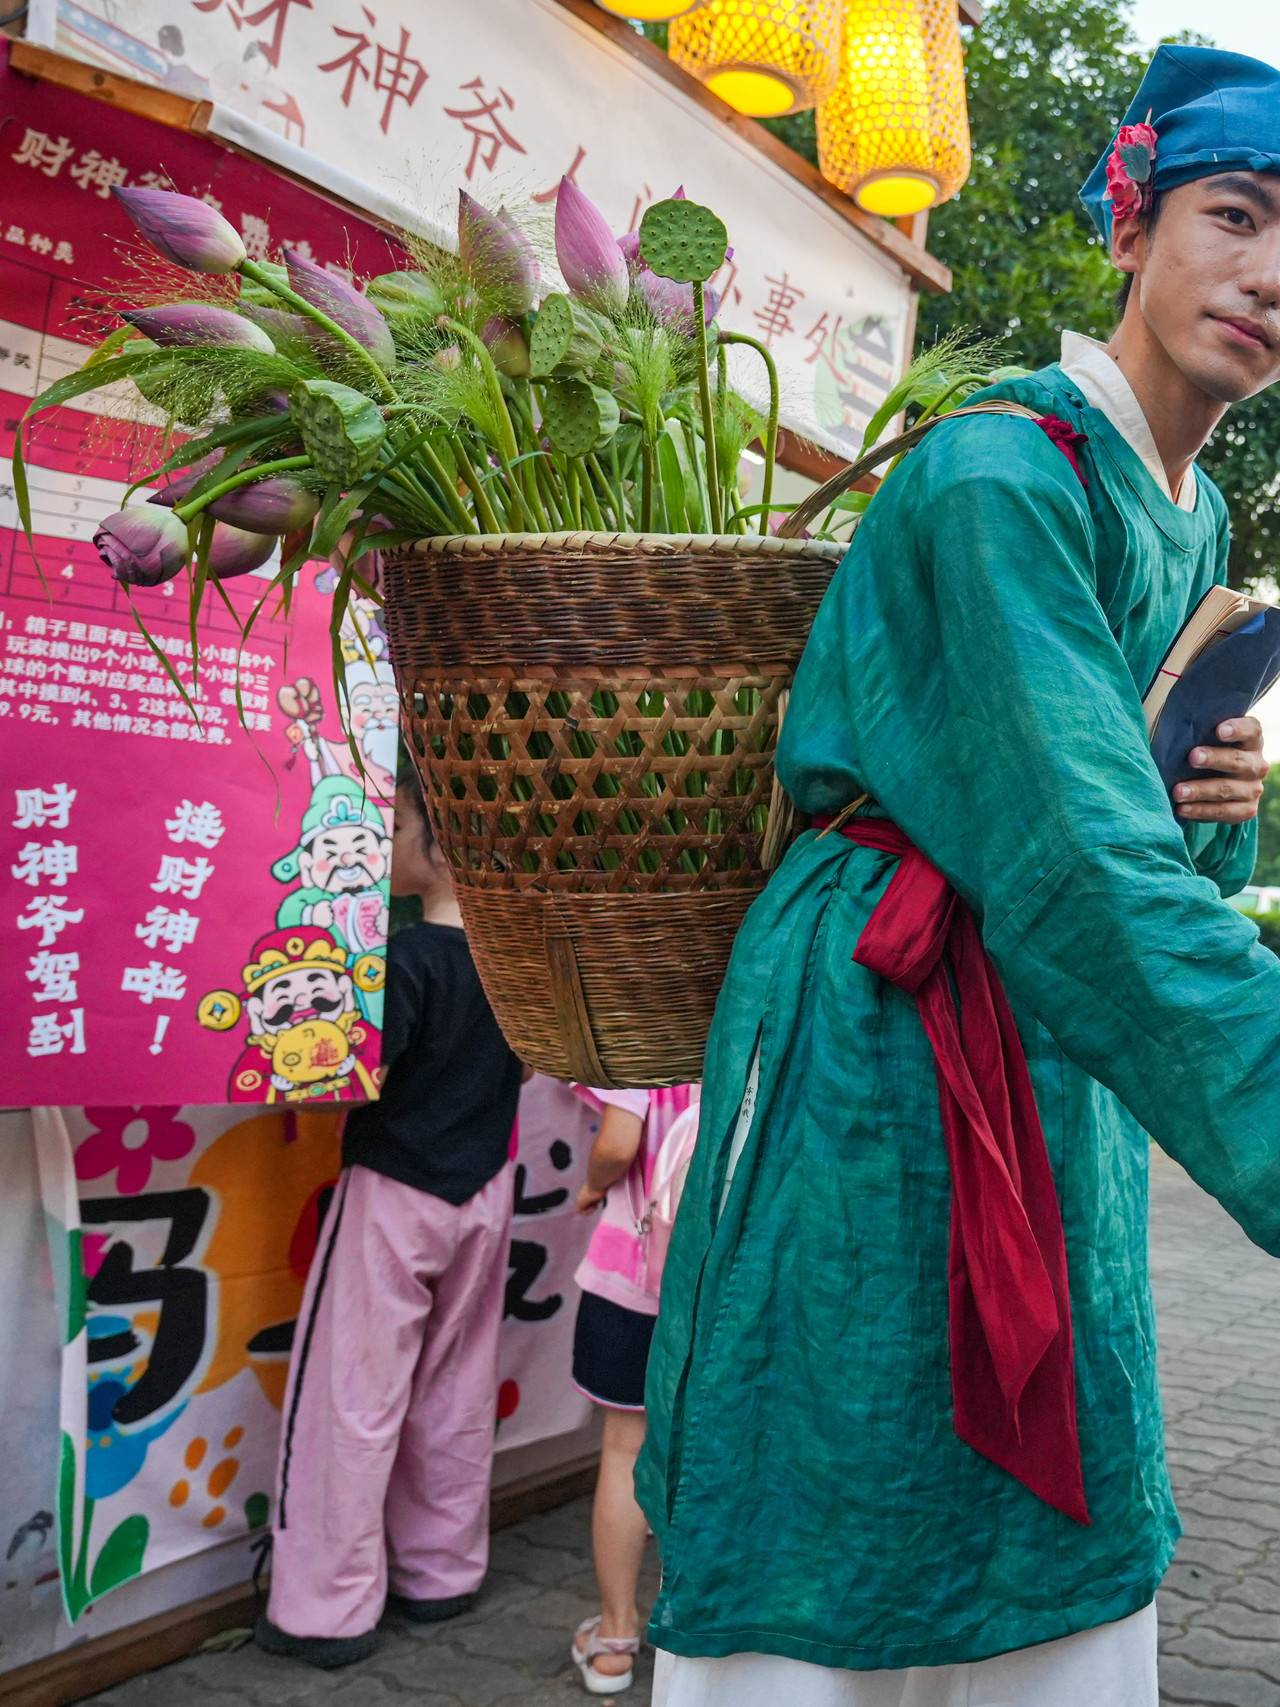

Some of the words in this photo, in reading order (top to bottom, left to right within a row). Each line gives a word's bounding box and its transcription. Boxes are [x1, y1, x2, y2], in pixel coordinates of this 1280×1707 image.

[61, 563, 75, 580] 4
[11, 782, 88, 1057] 财神爷驾到
